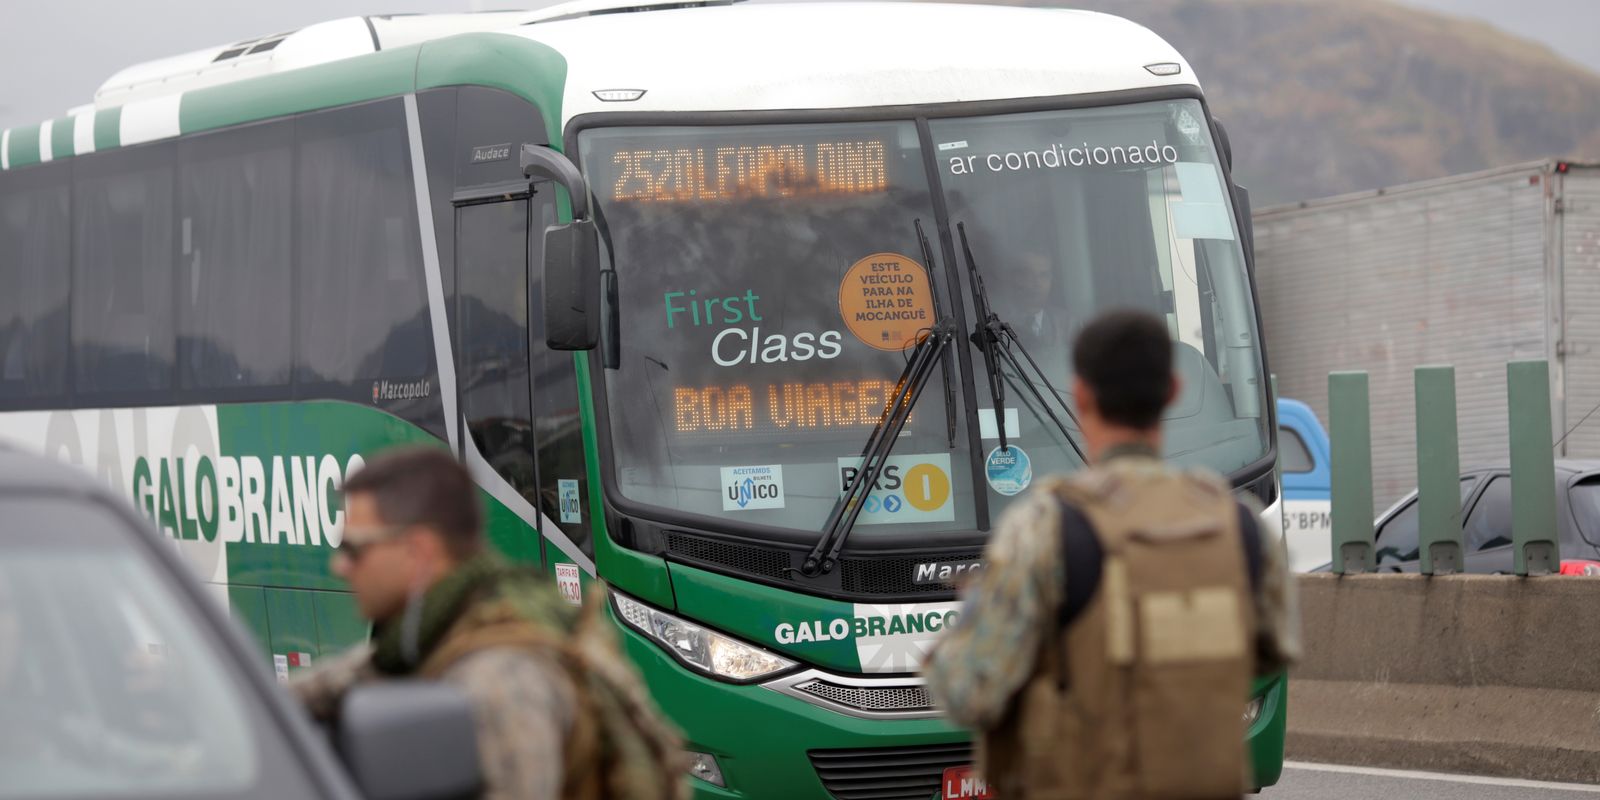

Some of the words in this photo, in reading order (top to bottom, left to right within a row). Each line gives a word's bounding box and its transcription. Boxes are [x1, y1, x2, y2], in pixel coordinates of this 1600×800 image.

[473, 147, 509, 161] Audace
[950, 155, 977, 175] ar
[986, 140, 1178, 172] condicionado
[871, 262, 900, 272] ESTE
[859, 273, 913, 284] VEÍCULO
[863, 287, 893, 296] PARA
[896, 286, 914, 295] NA
[664, 289, 762, 329] First
[865, 300, 895, 309] ILHA
[897, 298, 913, 308] DE
[855, 308, 926, 322] MOCANGUÊ
[711, 327, 842, 367] Class
[380, 379, 430, 401] Marcopolo
[675, 385, 752, 431] BOA
[991, 457, 1016, 465] VERDE
[733, 467, 771, 475] ACEITAMOS
[728, 480, 778, 501] ÚNICO
